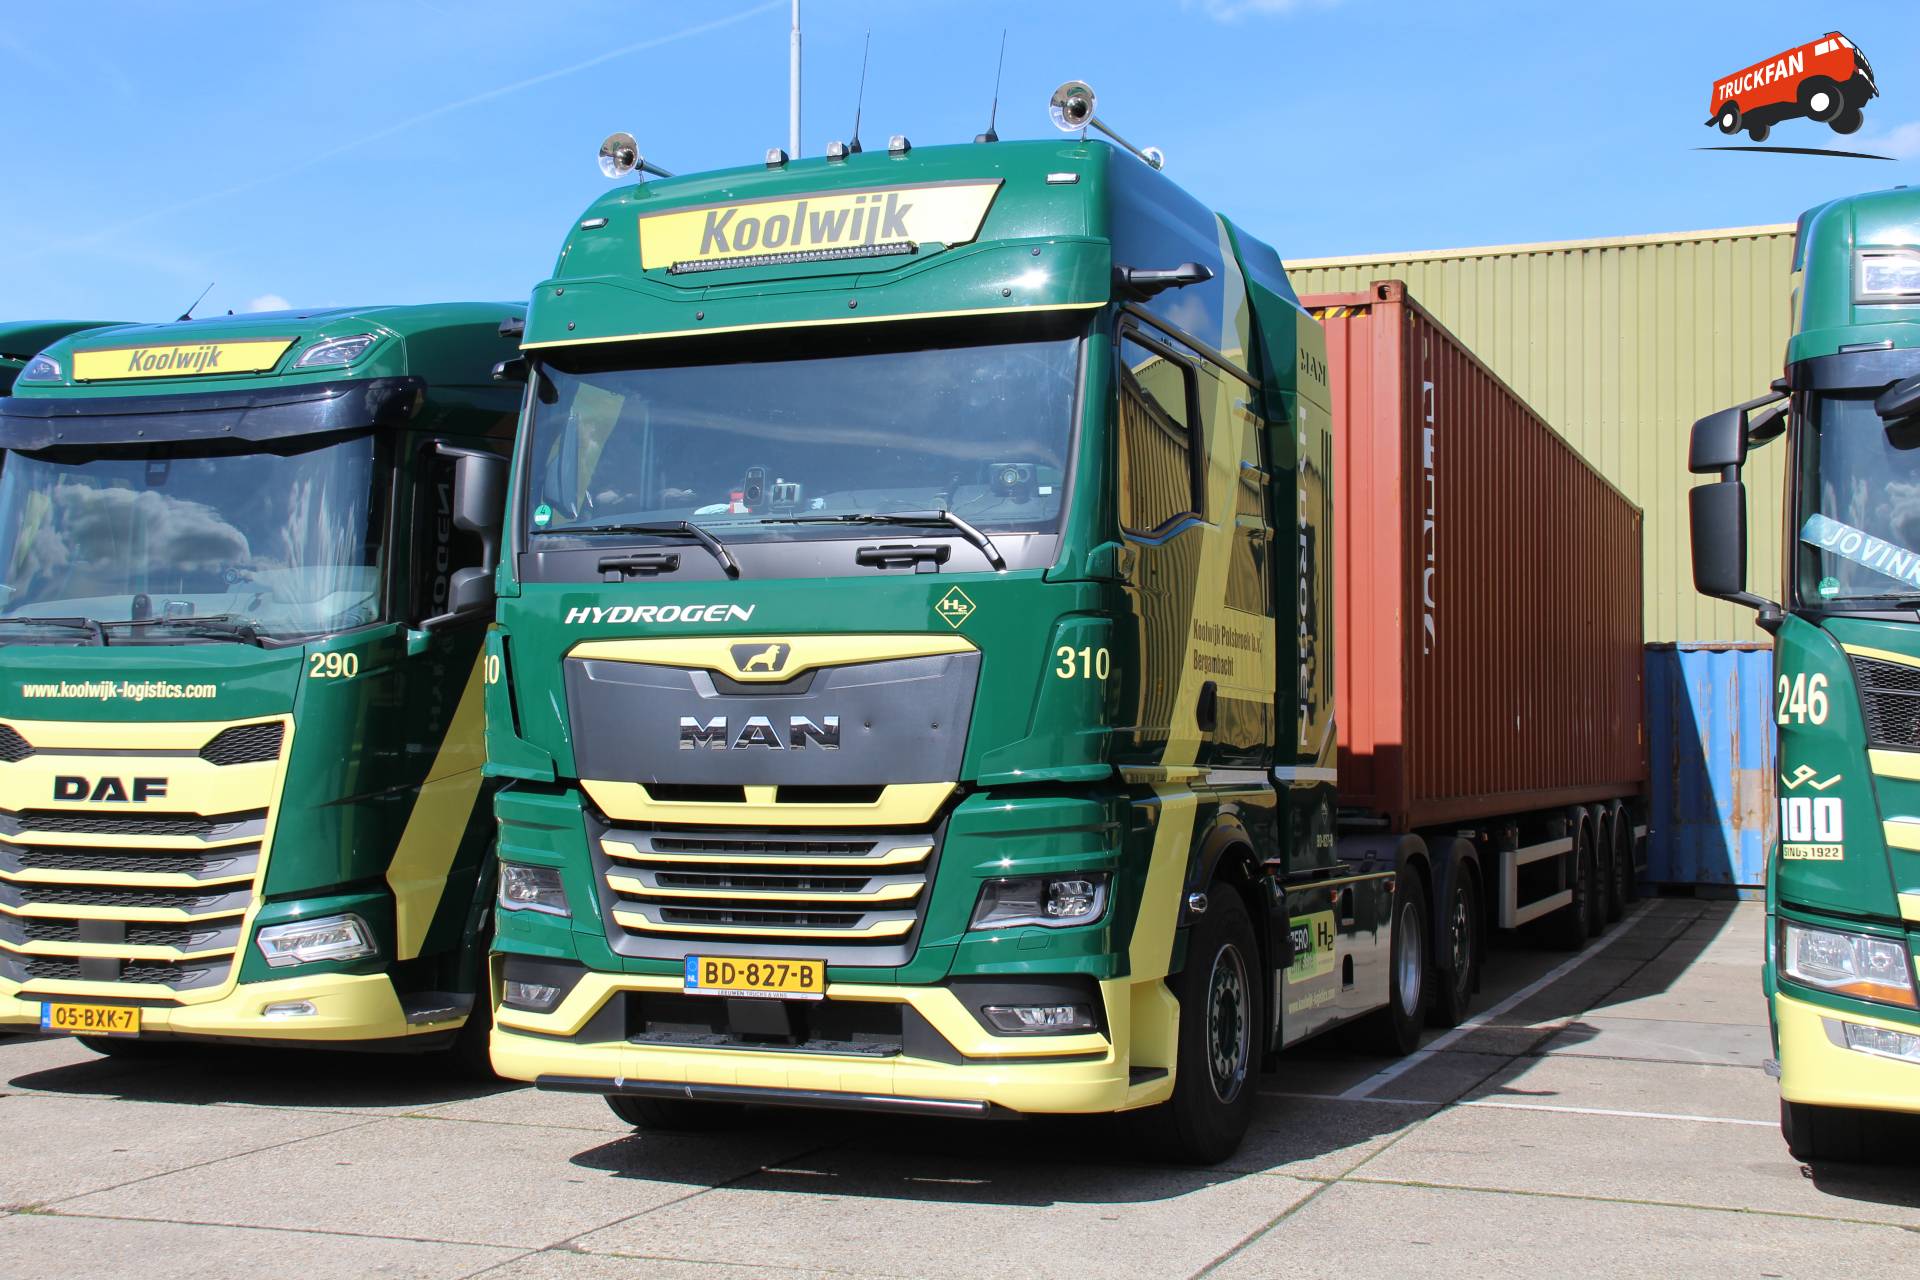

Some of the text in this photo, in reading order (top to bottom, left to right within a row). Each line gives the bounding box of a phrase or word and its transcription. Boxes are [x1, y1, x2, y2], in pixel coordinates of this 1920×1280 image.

[699, 193, 914, 255] Koolwijk
[128, 345, 223, 373] Koolwijk
[1299, 406, 1308, 746] HYDROGEN
[565, 604, 756, 625] HYDROGEN
[1193, 618, 1221, 646] Koolwijk
[309, 653, 358, 679] 290
[1055, 646, 1110, 680] 310
[1193, 648, 1234, 677] Bergambacht
[23, 680, 217, 701] www.koolwijk-logistics.com
[1778, 672, 1828, 725] 246
[680, 715, 841, 751] MAN
[53, 776, 168, 802] DAF
[1781, 797, 1843, 842] 100
[1811, 847, 1839, 858] 1922
[705, 961, 814, 988] BD-827-B
[56, 1007, 133, 1029] 05-BXK-7
